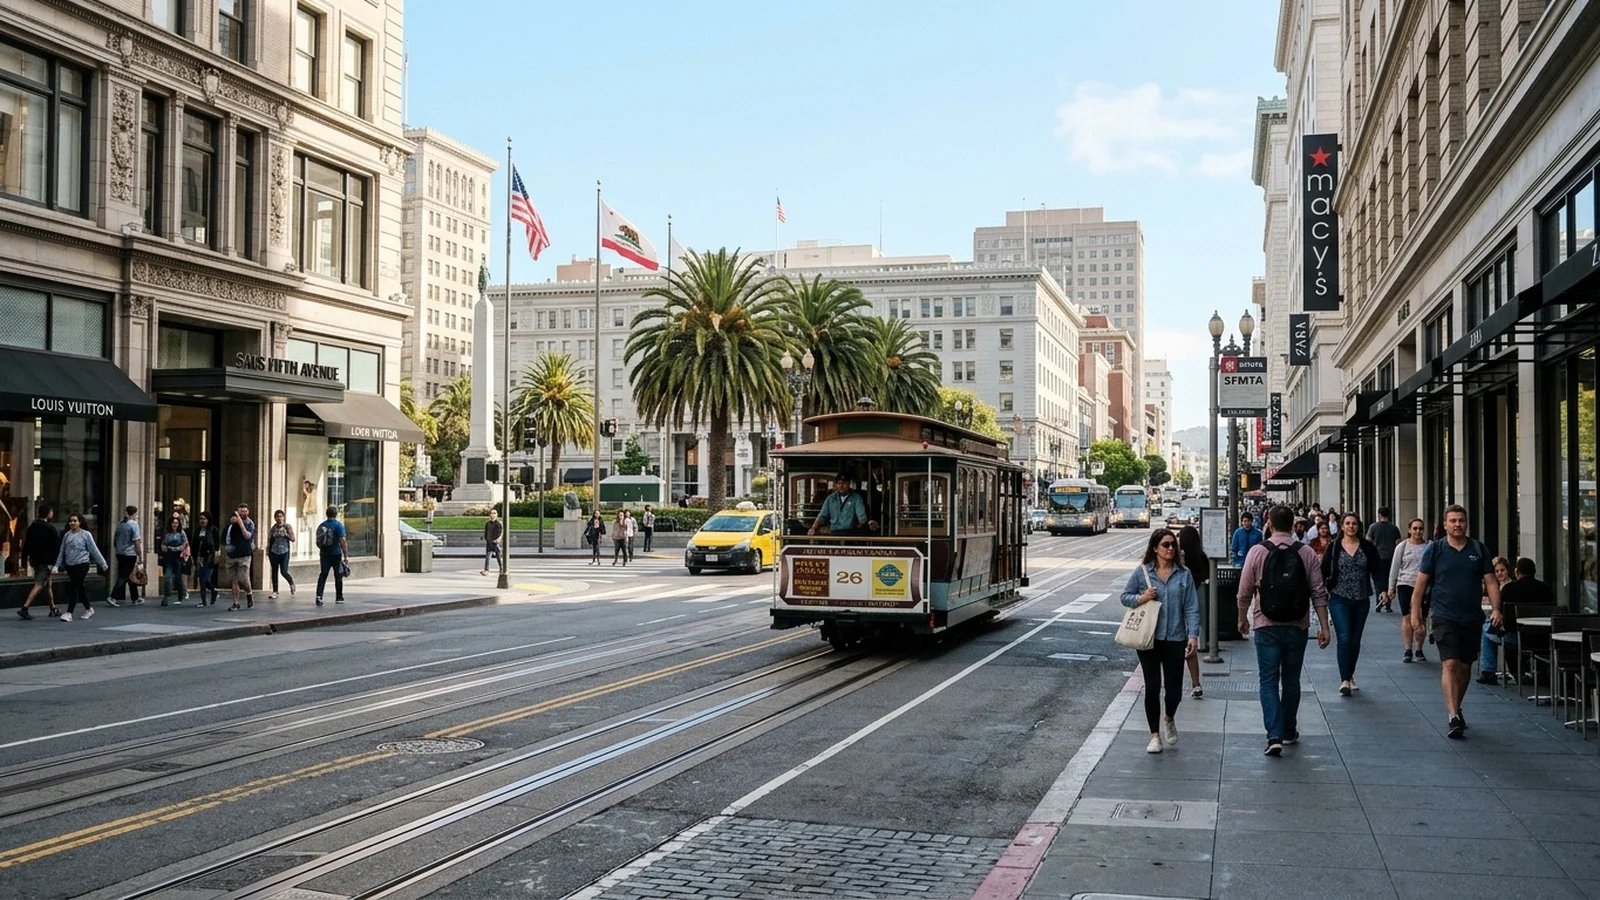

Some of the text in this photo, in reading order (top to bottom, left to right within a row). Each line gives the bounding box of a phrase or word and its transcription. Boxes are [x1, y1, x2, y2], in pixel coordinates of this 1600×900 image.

[1307, 173, 1333, 296] macy's
[1224, 376, 1264, 385] SFMTA
[31, 398, 114, 416] LOUIS VUITTON
[836, 571, 863, 584] 26
